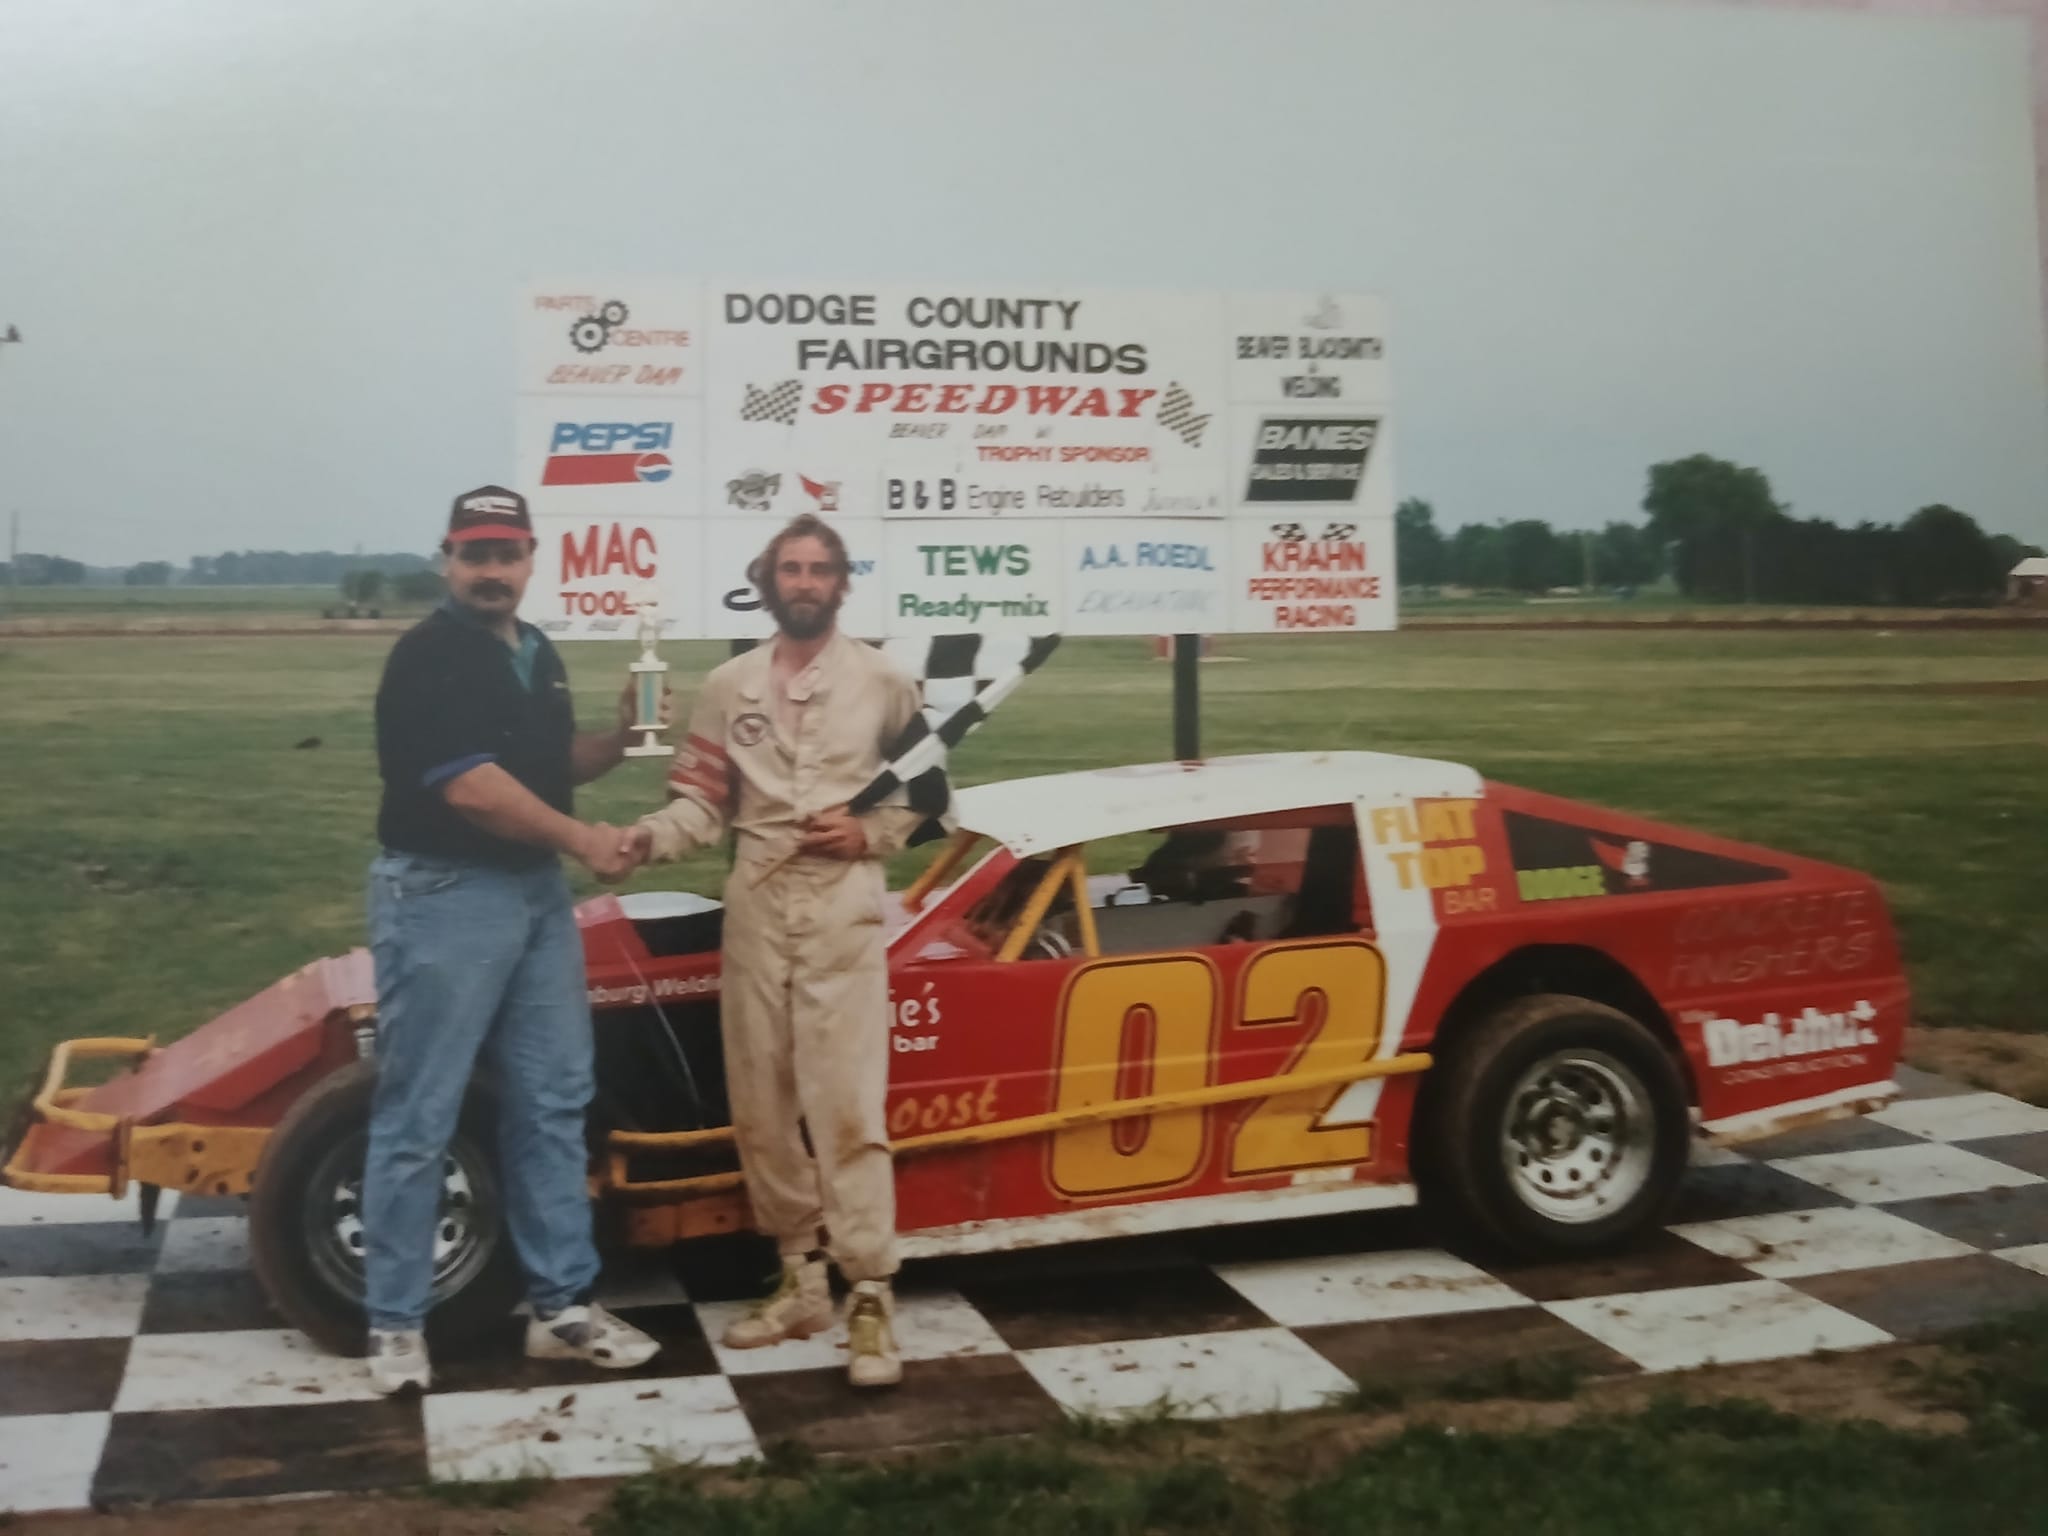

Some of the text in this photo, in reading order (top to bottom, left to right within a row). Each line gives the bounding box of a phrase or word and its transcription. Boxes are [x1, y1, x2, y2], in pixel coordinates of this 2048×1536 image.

[725, 295, 1080, 329] DODGE COUNTY
[798, 340, 1148, 374] FAIRGROUNDS
[810, 384, 1156, 417] SPEEDWAY
[550, 423, 672, 452] PEPSI
[1260, 425, 1373, 449] BANES
[977, 446, 1151, 462] TROPHY SPONSOR
[888, 478, 904, 510] B
[940, 478, 956, 510] B
[967, 484, 1026, 515] Engine
[1037, 484, 1126, 508] Rebuilders
[560, 522, 657, 584] MAC
[917, 545, 1030, 576] TEWS
[1136, 541, 1215, 571] ROEDL
[1263, 542, 1366, 572] KRAHN
[558, 591, 638, 616] TOOL
[1249, 578, 1380, 600] PERFORMANCE
[900, 593, 1049, 624] Ready-mix
[1276, 606, 1356, 628] RACING
[1371, 800, 1477, 845] FLAT
[1387, 845, 1485, 890] TOP
[1443, 888, 1497, 914] BAR
[1673, 890, 1869, 943] CONCRETE
[1664, 931, 1877, 989] FINISHERS
[888, 981, 940, 1027] ie's
[1042, 936, 1385, 1201] 02
[890, 1077, 1000, 1133] oost
